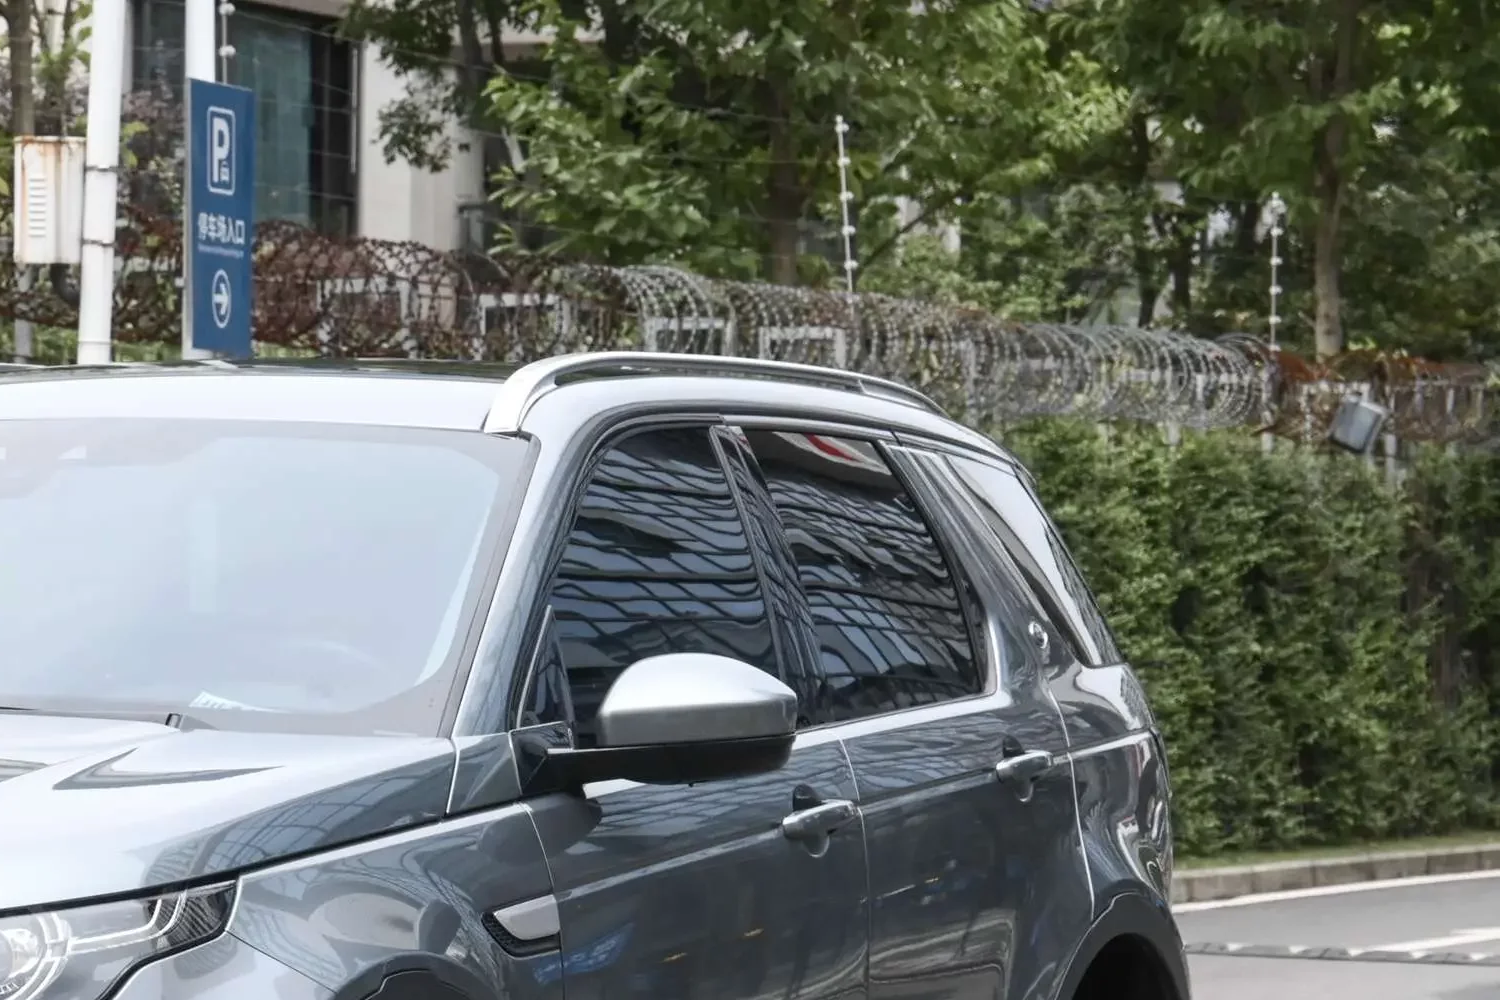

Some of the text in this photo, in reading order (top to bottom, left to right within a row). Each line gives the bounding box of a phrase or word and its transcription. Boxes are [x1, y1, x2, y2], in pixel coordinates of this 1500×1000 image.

[212, 116, 231, 183] P
[197, 211, 246, 245] 停车场入口
